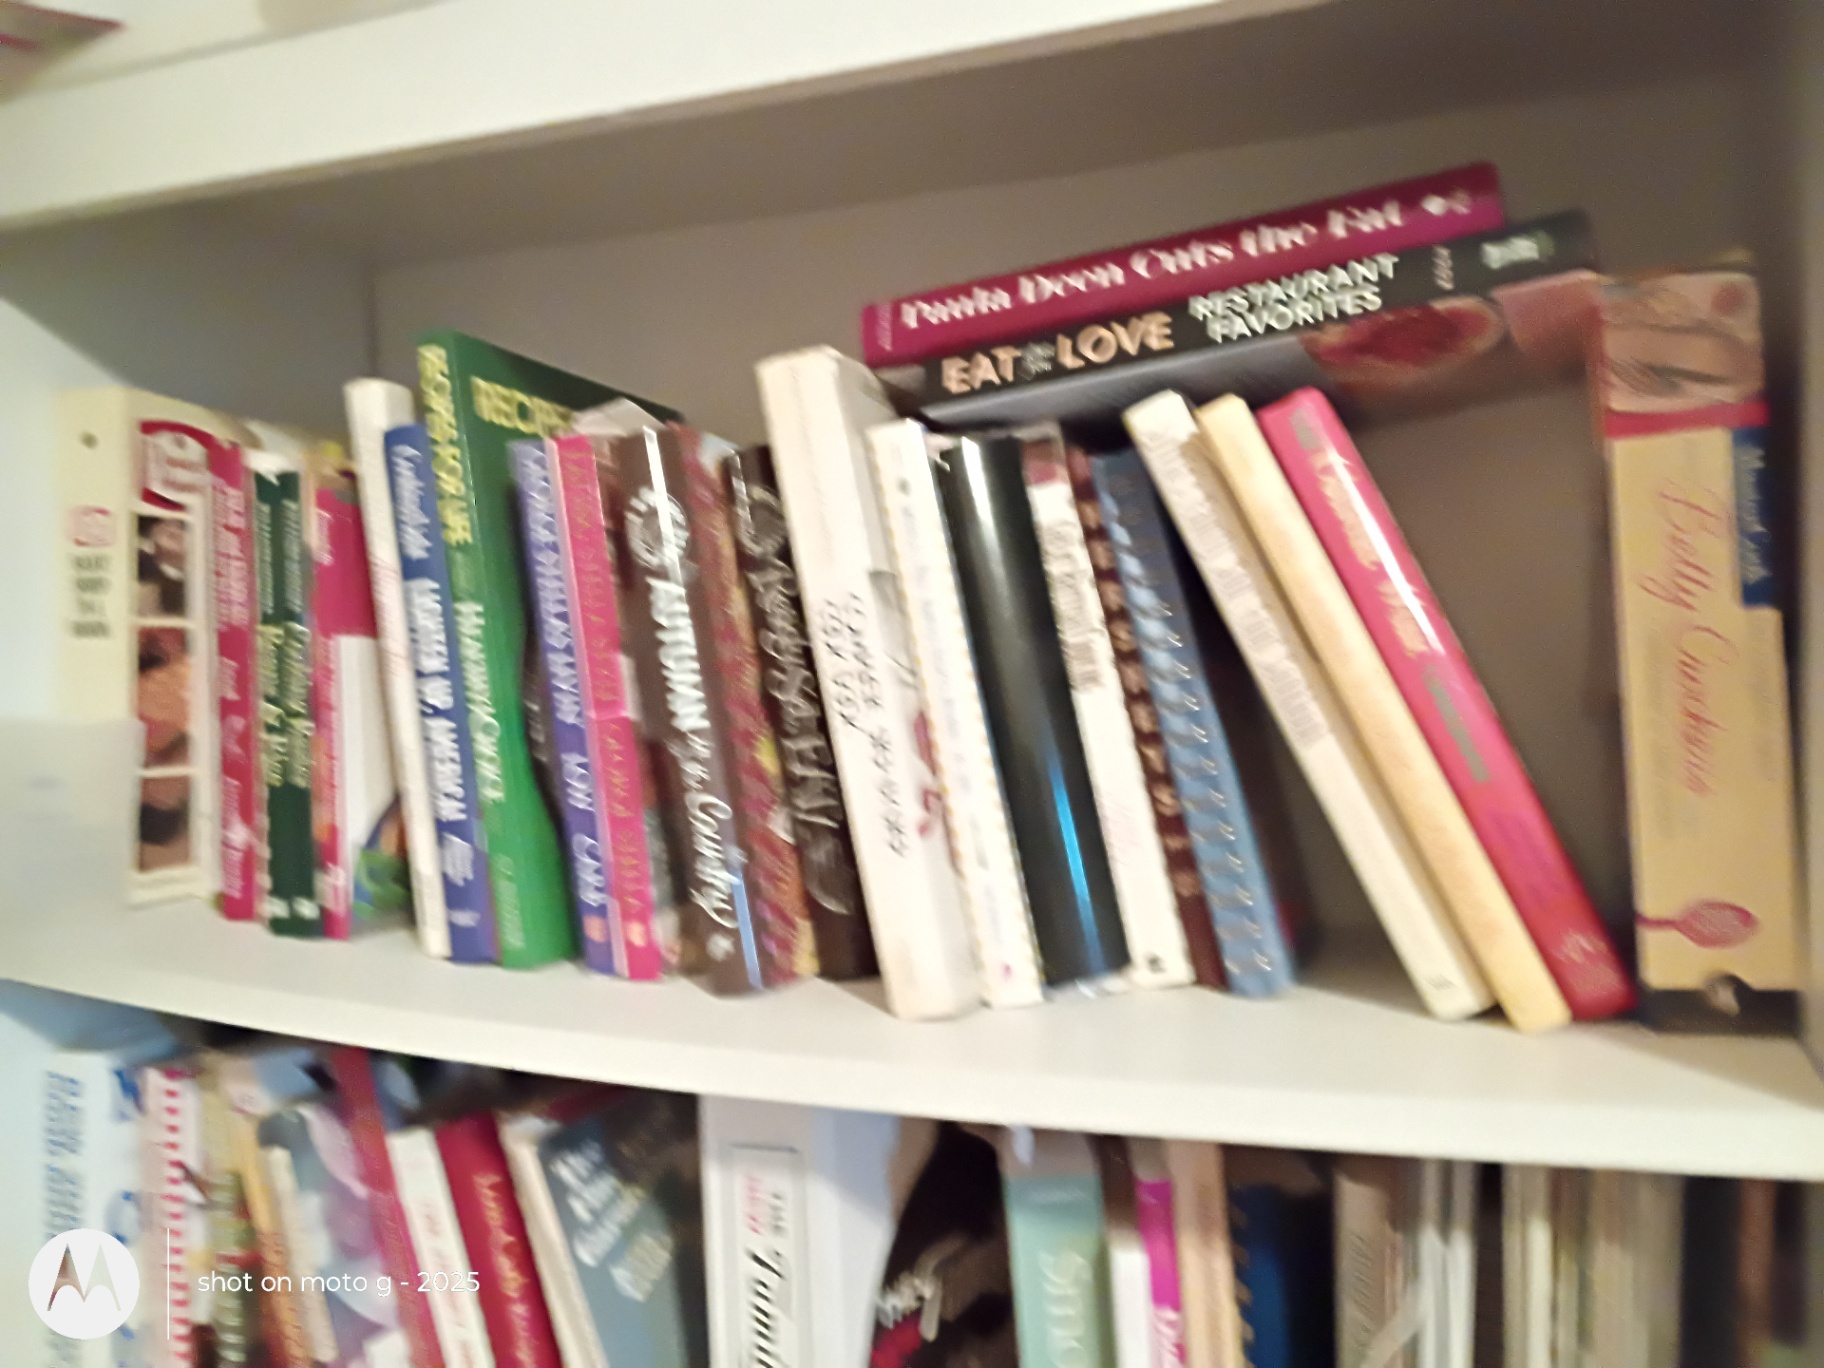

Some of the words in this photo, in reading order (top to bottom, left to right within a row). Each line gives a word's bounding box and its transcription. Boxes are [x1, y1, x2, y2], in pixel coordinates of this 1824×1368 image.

[901, 286, 1012, 329] Paula
[1018, 262, 1125, 304] Deen
[1129, 239, 1234, 279] Cuts
[1239, 222, 1317, 257] the
[1327, 200, 1403, 239] Fat
[1188, 253, 1398, 320] RESTAURANT
[941, 346, 1021, 394] EAT
[1056, 311, 1174, 369] LOVE
[1206, 283, 1382, 343] FAVORITES
[416, 343, 457, 440] RECIPES
[431, 441, 464, 498] FOR
[438, 498, 472, 546] LIFE
[406, 578, 450, 673] LIGHTEN
[467, 704, 505, 804] CHOICE
[561, 750, 596, 813] LOW
[648, 577, 711, 730] AUTUMN
[685, 792, 742, 930] Country
[571, 831, 609, 907] CARB
